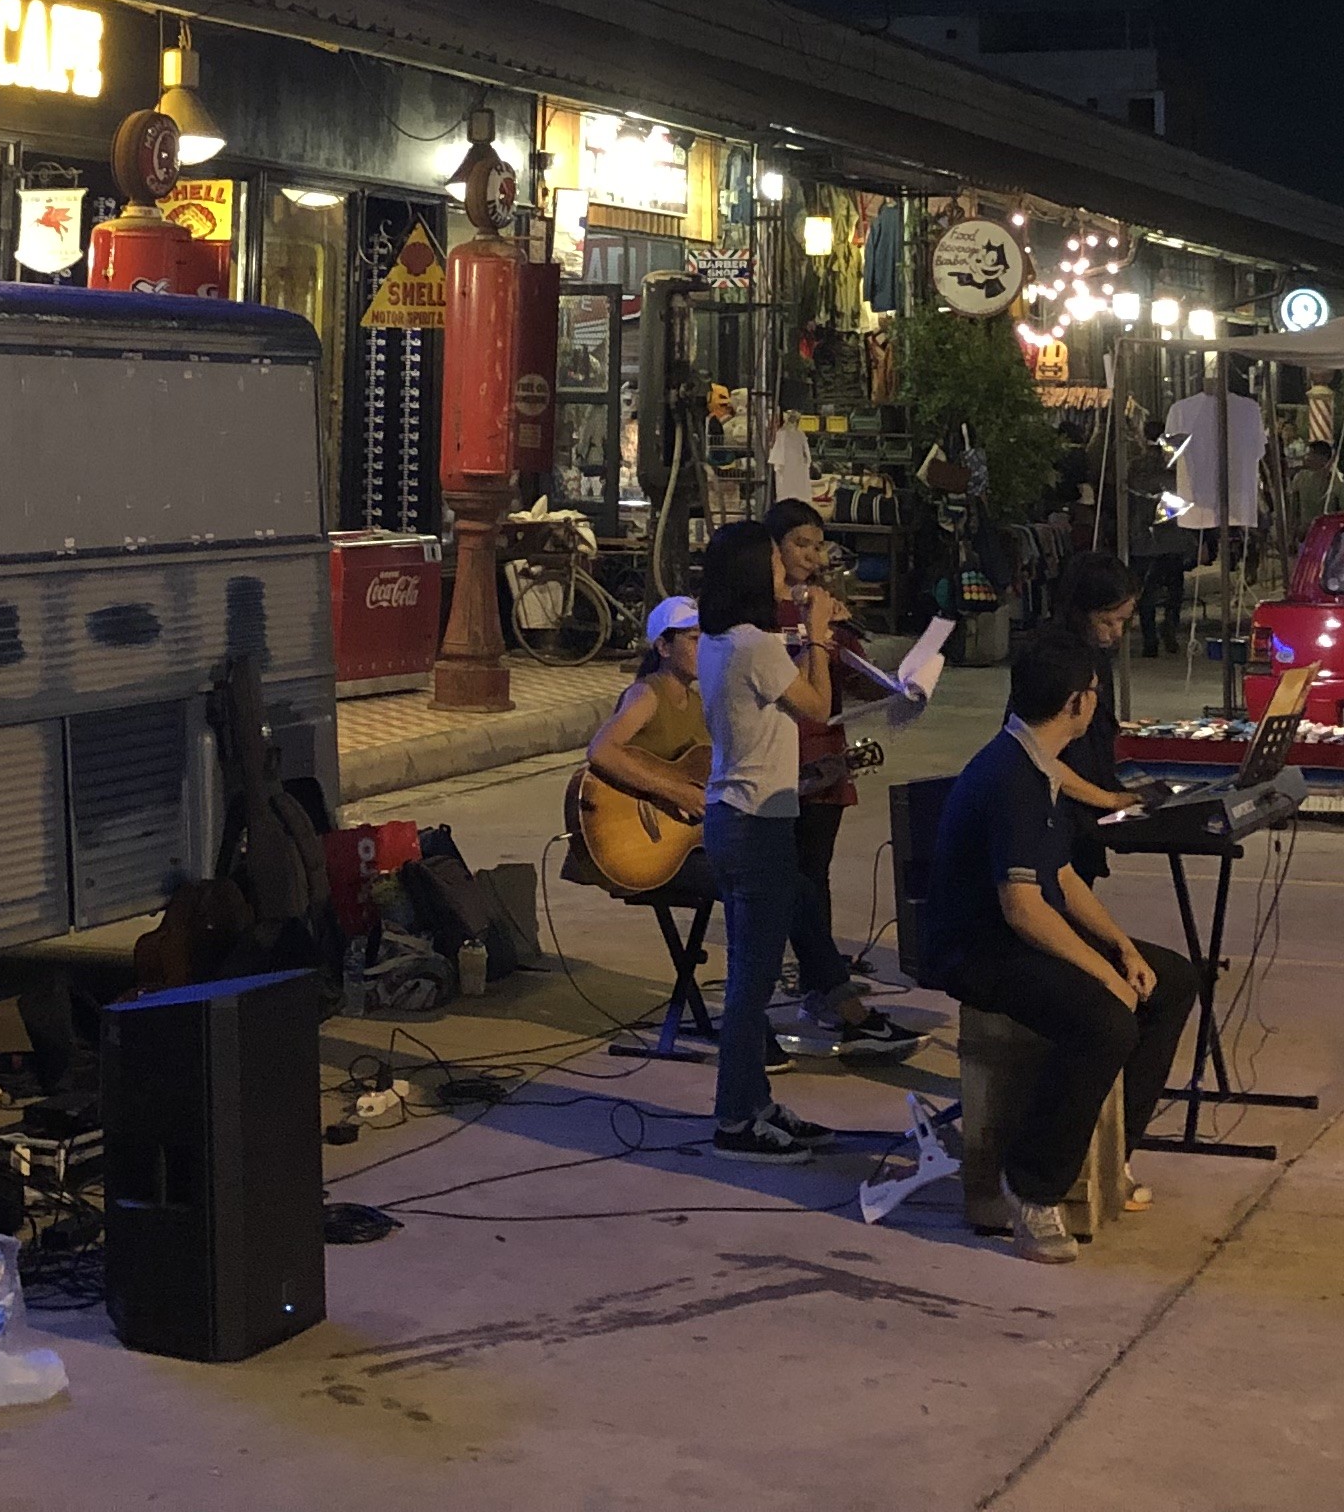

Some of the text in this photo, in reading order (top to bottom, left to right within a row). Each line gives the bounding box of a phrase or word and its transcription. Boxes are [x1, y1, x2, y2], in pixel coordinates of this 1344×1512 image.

[698, 260, 748, 269] BARBER
[707, 269, 740, 278] SHOP
[371, 311, 404, 324] MOTOR
